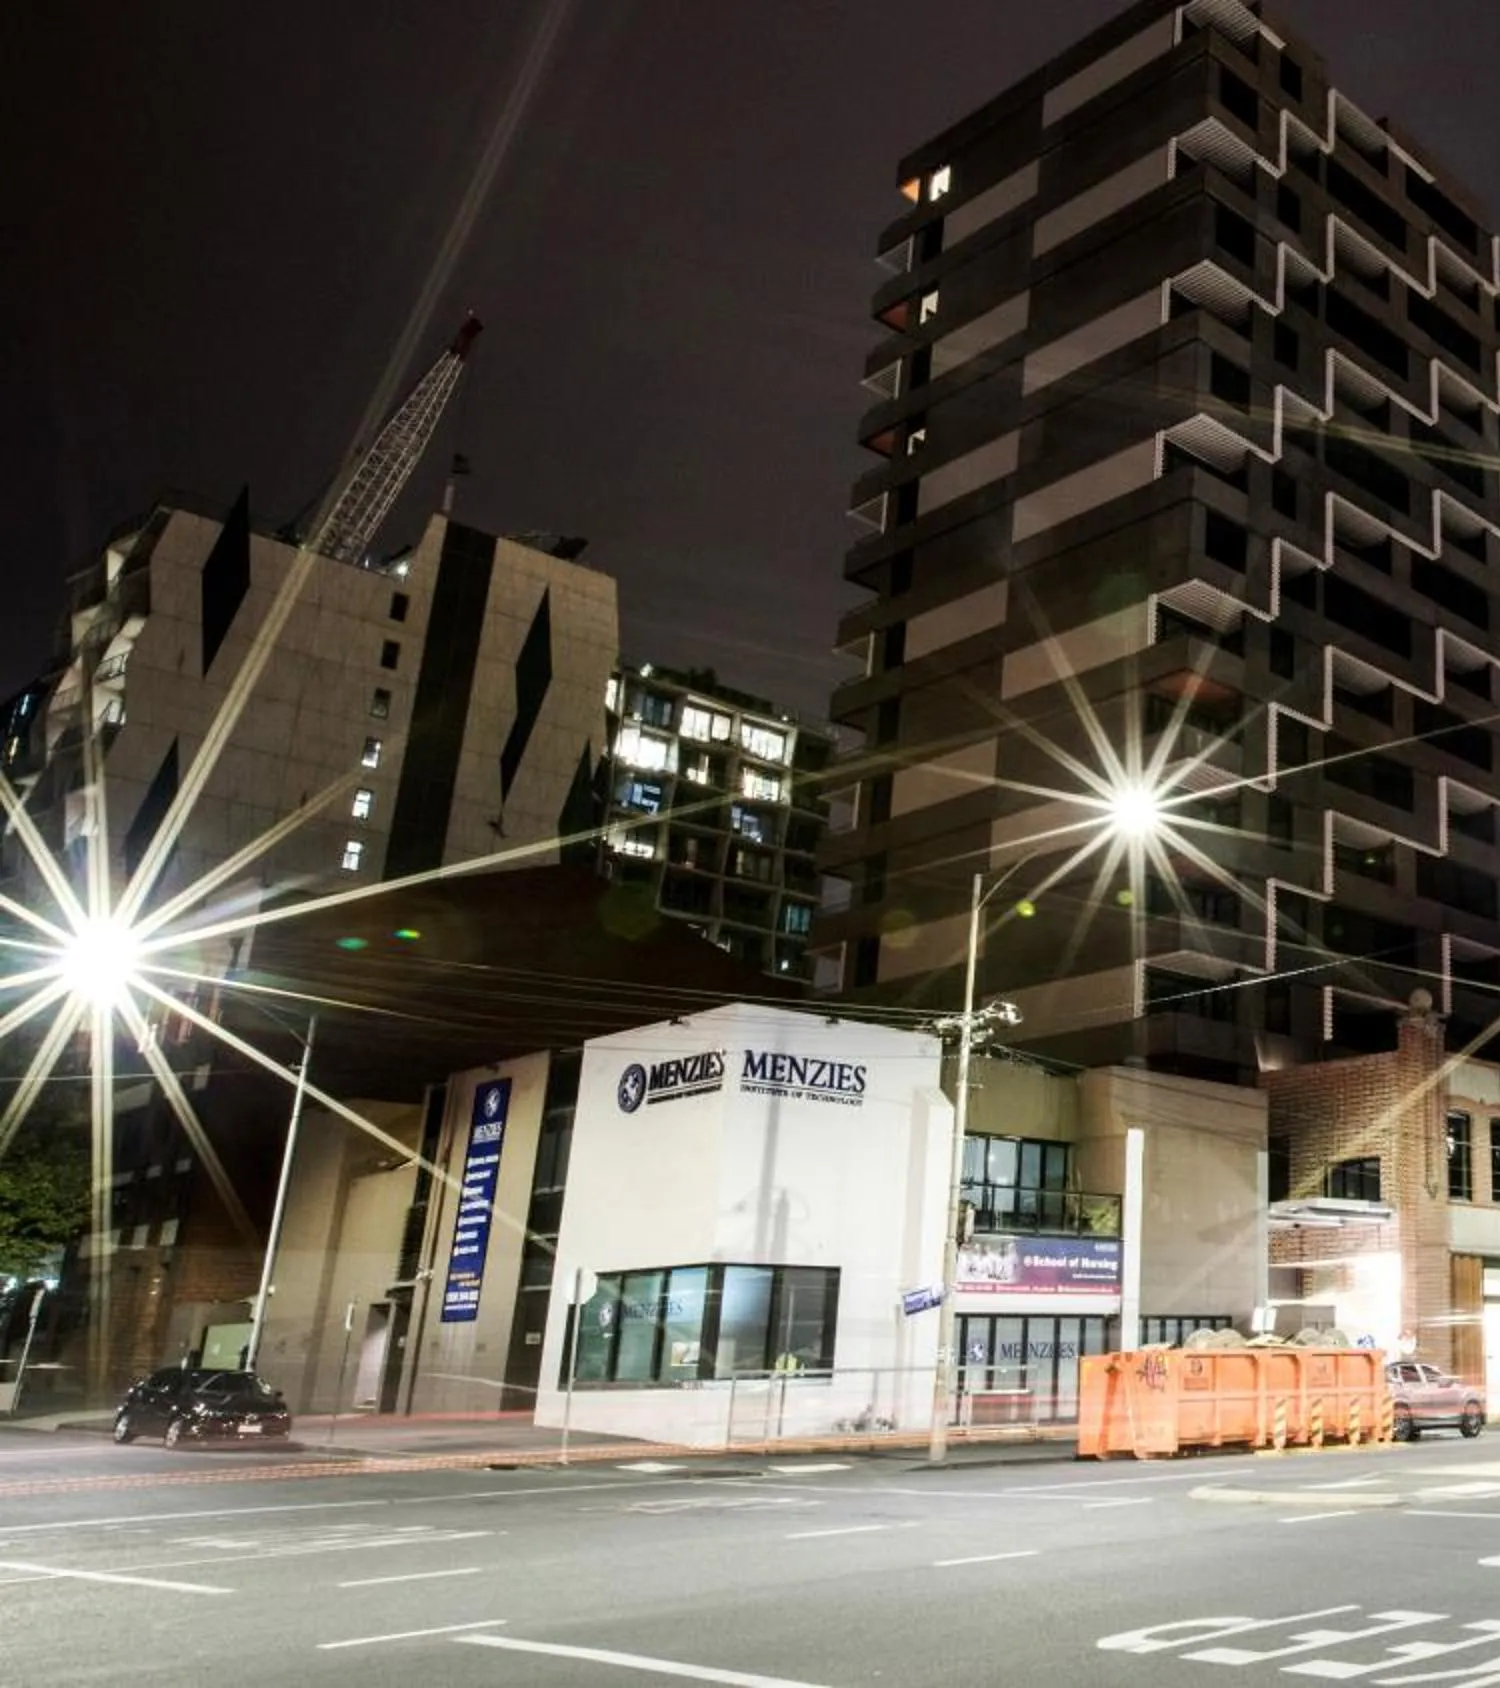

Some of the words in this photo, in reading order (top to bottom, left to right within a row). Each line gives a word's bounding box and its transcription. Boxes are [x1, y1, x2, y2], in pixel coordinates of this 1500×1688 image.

[648, 1051, 725, 1090] MENZIES
[741, 1049, 867, 1093] MENZIES
[1033, 1256, 1067, 1268] School
[1068, 1256, 1079, 1268] of
[1081, 1257, 1118, 1271] Nursing
